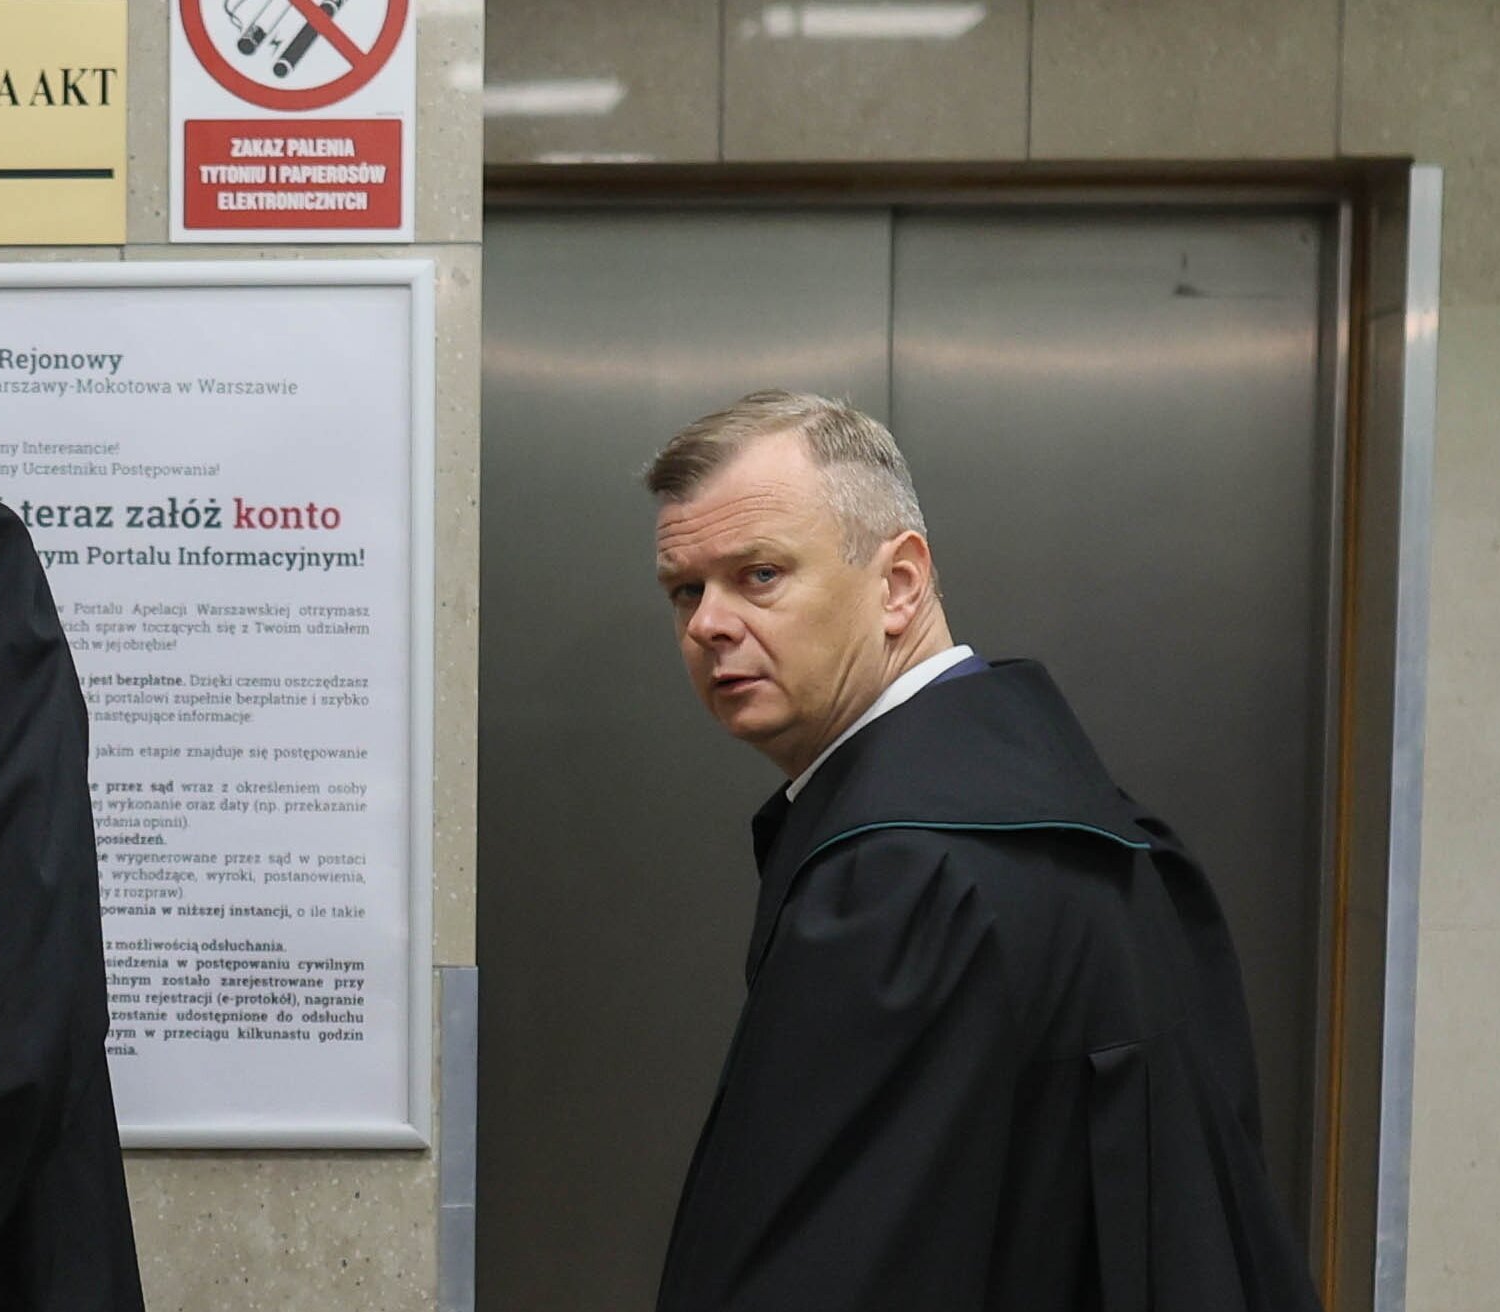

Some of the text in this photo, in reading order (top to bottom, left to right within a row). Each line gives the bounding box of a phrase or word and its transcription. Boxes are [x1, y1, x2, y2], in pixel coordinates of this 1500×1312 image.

[29, 67, 117, 107] AKT
[229, 137, 356, 158] ZAKAZ PALENIA
[199, 162, 387, 184] TYTONIU I PAPIEROSÓW
[217, 191, 369, 211] ELEKTRONICZNYCH
[177, 384, 193, 395] w
[199, 379, 298, 396] Warszawie
[23, 441, 121, 456] Interesancie!
[23, 462, 108, 476] Uczestniku
[111, 463, 221, 480] Postępowania!
[21, 498, 342, 531] teraz załóż konto
[86, 546, 171, 568] Portalu
[178, 547, 366, 573] Informacyjnym!
[74, 600, 123, 616] Portalu
[132, 600, 187, 619] Apelacji
[197, 601, 290, 620] Warszawskiej
[299, 604, 370, 621] otrzymasz
[96, 622, 137, 637] spraw
[142, 618, 211, 637] toczących
[218, 619, 236, 638] się
[254, 619, 302, 635] Twoim
[307, 620, 370, 636] udziałem
[88, 671, 113, 690] jest
[116, 671, 187, 690] bezpłatne.
[190, 672, 232, 691] Dzięki
[235, 676, 281, 688] czemu
[284, 673, 369, 692] oszczędzasz
[105, 689, 170, 708] portalowi
[174, 689, 232, 708] zupełnie
[235, 690, 307, 709] bezpłatnie
[320, 691, 370, 710] szybko
[95, 707, 175, 726] następujące
[95, 743, 369, 763] jakim etapie znajduje się postępowanie
[106, 782, 144, 796] przez
[150, 778, 175, 796] sąd
[181, 782, 214, 793] wraz
[236, 779, 321, 794] określeniem
[328, 780, 368, 798] osoby
[107, 796, 183, 814] wykonanie
[186, 800, 216, 811] oraz
[219, 797, 250, 815] daty
[253, 797, 281, 815] (np.
[284, 798, 368, 816] przekazanie
[95, 814, 141, 832] ydania
[115, 853, 218, 867] wygenerowane
[224, 854, 262, 868] przez
[268, 850, 292, 868] sąd
[318, 851, 366, 869] postaci
[112, 867, 199, 885] wychodzące,
[206, 868, 257, 886] wyroki,
[264, 869, 367, 887] postanowienia,
[177, 902, 226, 920] niższej
[229, 903, 293, 921] instancji,
[310, 904, 327, 919] ile
[332, 904, 366, 919] takie
[115, 937, 200, 955] możliwością
[201, 938, 288, 953] odsłuchania.
[106, 955, 169, 970] siedzenia
[195, 956, 291, 974] postępowaniu
[297, 957, 366, 975] cywilnym
[161, 972, 211, 987] zostało
[220, 973, 325, 991] zarejestrowane
[334, 978, 366, 992] przy
[145, 990, 213, 1008] rejestracji
[304, 992, 365, 1010] nagranie
[110, 1007, 365, 1026] zostanie udostępnione do odsłuchu
[163, 1025, 230, 1043] przeciągu
[237, 1026, 311, 1041] kilkunastu
[318, 1027, 365, 1045] godzin
